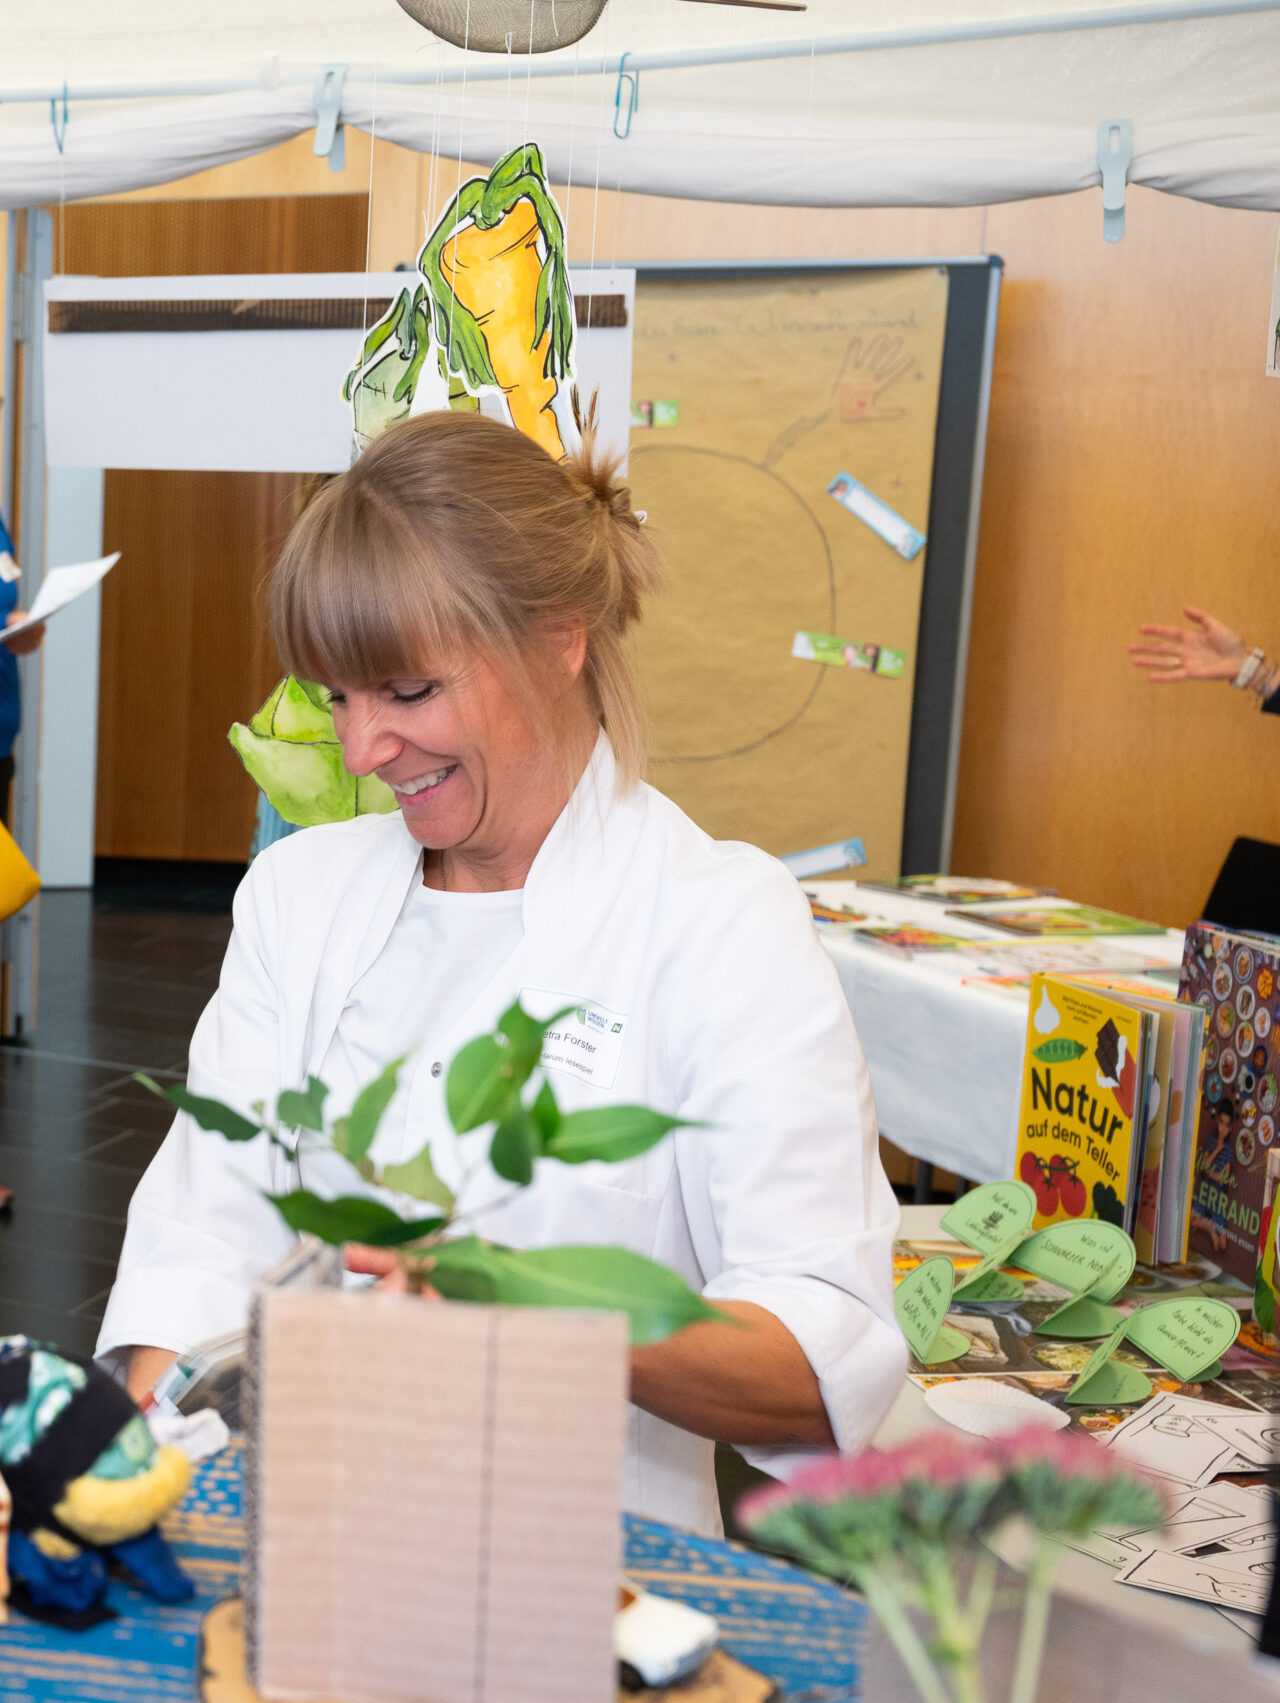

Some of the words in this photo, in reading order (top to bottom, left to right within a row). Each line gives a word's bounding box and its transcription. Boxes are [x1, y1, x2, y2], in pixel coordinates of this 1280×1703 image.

[543, 1029, 561, 1041] etra
[563, 1032, 597, 1054] Forster
[1031, 1066, 1124, 1145] Natur
[1026, 1117, 1049, 1140] auf
[1051, 1120, 1082, 1149] dem
[1086, 1135, 1121, 1182] Teller
